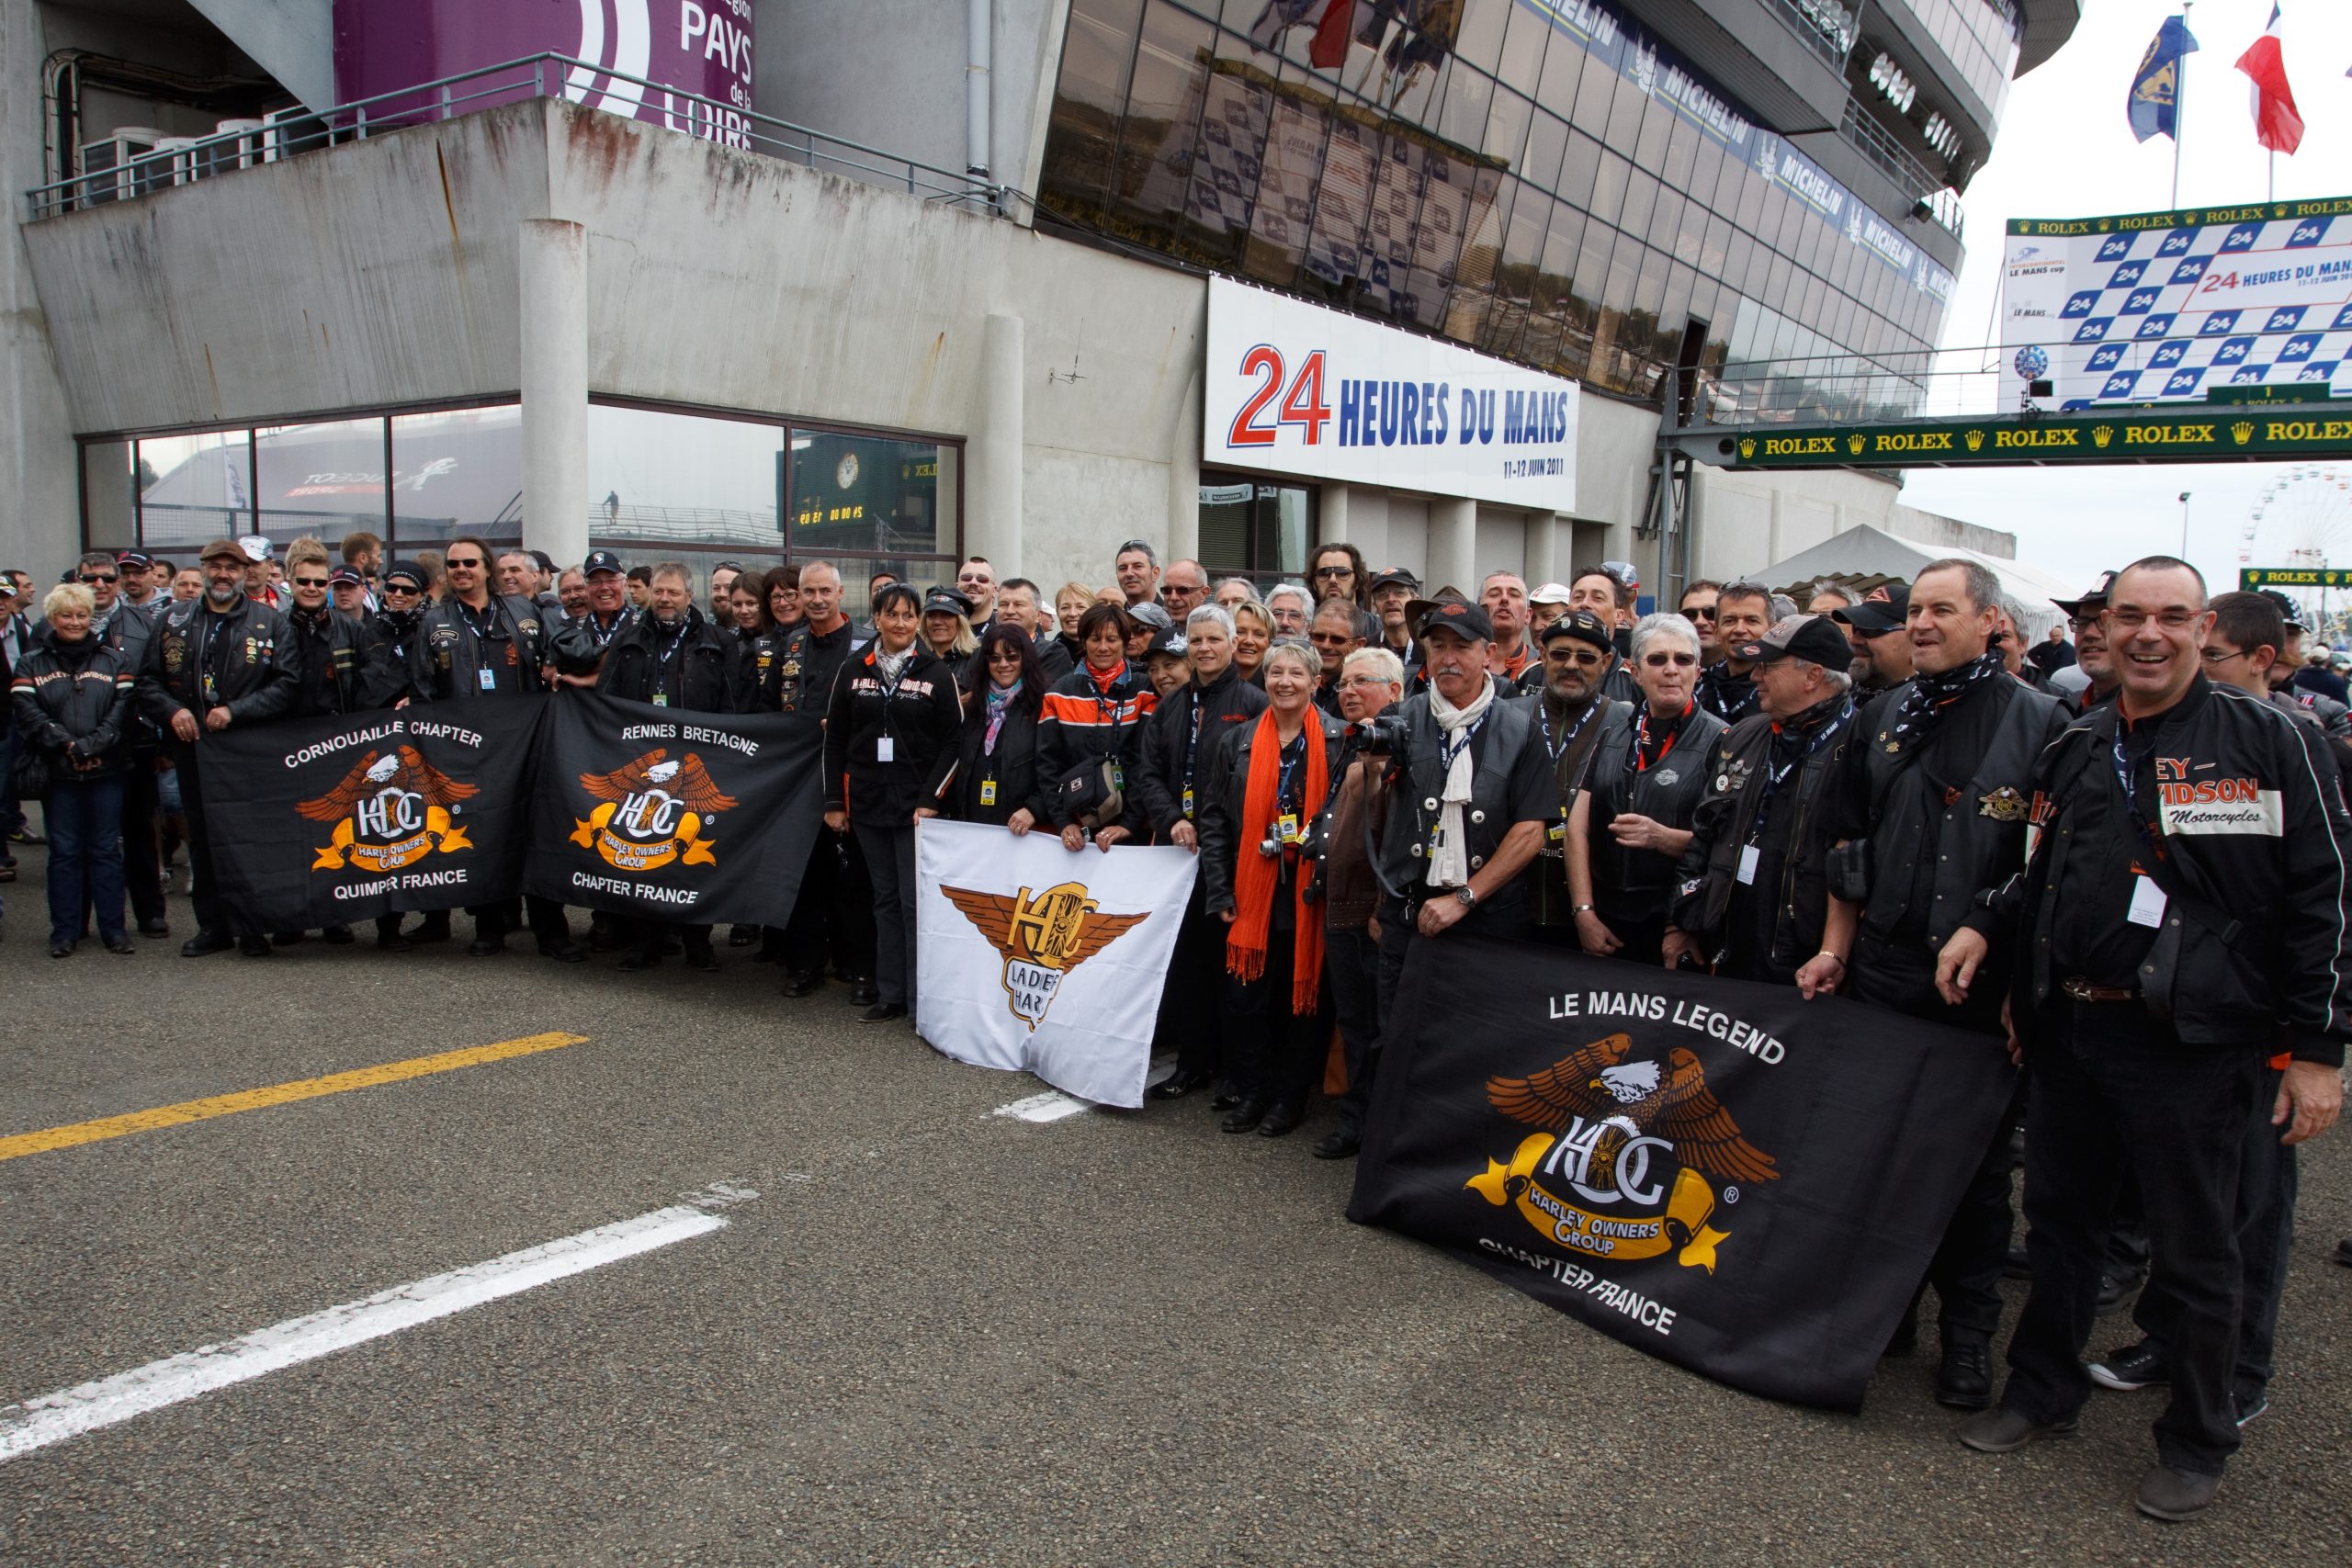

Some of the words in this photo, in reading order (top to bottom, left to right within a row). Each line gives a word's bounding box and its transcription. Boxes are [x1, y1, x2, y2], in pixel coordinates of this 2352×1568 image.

[681, 1, 752, 85] PAYS
[730, 81, 743, 107] de
[1664, 64, 1749, 144] MICHELIN
[1781, 154, 1842, 215] MICHELIN
[2038, 221, 2089, 234] ROLEX
[2119, 215, 2176, 230] ROLEX
[2206, 208, 2264, 223] ROLEX
[2297, 200, 2352, 215] ROLEX
[2228, 231, 2253, 246] 24
[2293, 226, 2319, 242] 24
[1864, 220, 1912, 268] MICHELIN
[2102, 241, 2127, 256] 24
[2164, 236, 2188, 251] 24
[2022, 266, 2048, 276] MANS
[2116, 267, 2140, 282] 24
[2177, 263, 2202, 278] 24
[2201, 271, 2240, 293] 24
[2243, 268, 2291, 287] HEURES
[2296, 265, 2314, 279] DU
[2319, 260, 2352, 276] MAN
[2340, 273, 2352, 281] 201
[2068, 298, 2091, 312] 24
[2130, 294, 2154, 309] 24
[2206, 317, 2231, 332] 24
[2270, 313, 2296, 329] 24
[2340, 310, 2352, 325] 2
[2079, 324, 2103, 338] 24
[2142, 321, 2165, 335] 24
[2156, 347, 2181, 362] 24
[2221, 344, 2246, 359] 24
[2284, 341, 2311, 355] 24
[2094, 350, 2118, 365] 24
[2169, 375, 2194, 389] 24
[2235, 371, 2258, 384] 24
[2301, 368, 2324, 380] 24
[2107, 378, 2131, 391] 24
[2265, 386, 2272, 397] 1
[1227, 343, 1330, 449] 24
[1339, 379, 1449, 447] HEURES
[1459, 389, 1495, 446] DU
[1503, 390, 1568, 445] MANS
[1765, 437, 1837, 455] ROLEX
[1875, 434, 1953, 451] ROLEX
[1995, 429, 2079, 447] ROLEX
[2124, 425, 2215, 444] ROLEX
[2267, 422, 2352, 440] ROLEX
[1503, 460, 1526, 479] 11-12
[1528, 460, 1545, 478] JUIN
[1546, 458, 1564, 477] 2011
[2267, 572, 2317, 582] ROLEX
[284, 720, 404, 769] CORNOUAILLE
[411, 721, 483, 749] CHAPTER
[622, 724, 676, 739] RENNES
[683, 726, 759, 757] BRETAGNE
[2169, 809, 2262, 825] Motorcycles
[358, 847, 389, 857] HARLE
[390, 836, 424, 855] OWNERS
[604, 833, 632, 854] HARLEY
[634, 842, 672, 857] OWNERS
[614, 850, 647, 868] GROUP
[334, 876, 399, 900] QUIMPER
[402, 869, 468, 889] FRANCE
[572, 872, 630, 897] CHAPTER
[635, 884, 698, 904] FRANCE
[1550, 993, 1579, 1020] LE
[1588, 991, 1668, 1021] MANS
[1672, 1000, 1786, 1066] LEGEND
[1530, 1187, 1586, 1229] HARLEY
[1590, 1218, 1660, 1239] OWNERS
[1554, 1219, 1615, 1255] GROUP
[1479, 1237, 1595, 1291] CHAPTER
[1590, 1278, 1677, 1336] FRANCE
